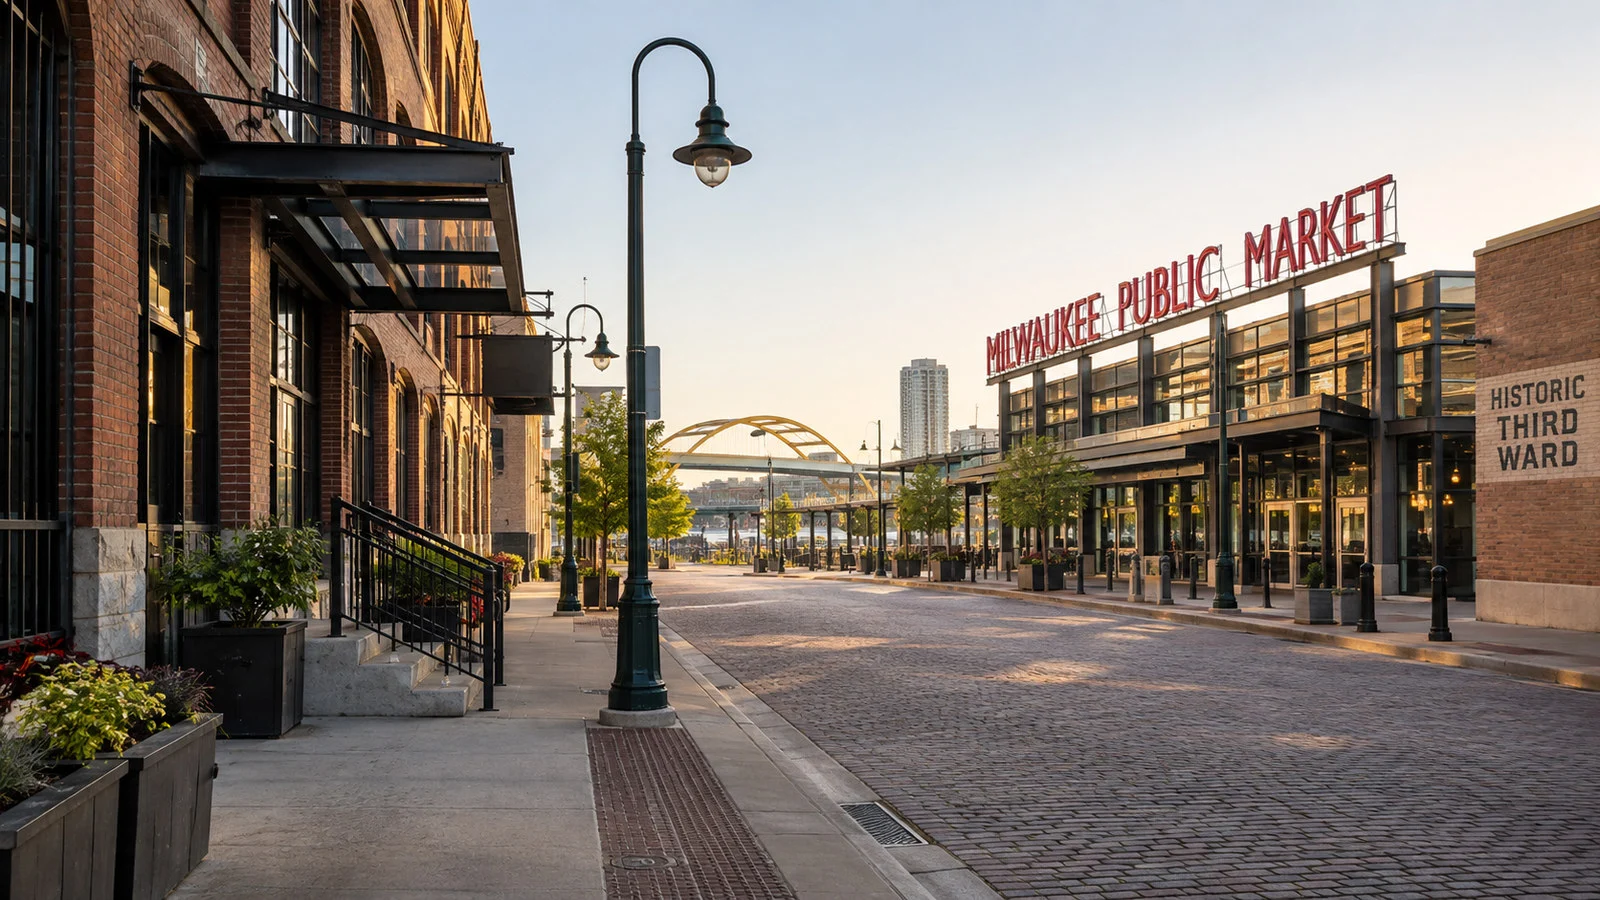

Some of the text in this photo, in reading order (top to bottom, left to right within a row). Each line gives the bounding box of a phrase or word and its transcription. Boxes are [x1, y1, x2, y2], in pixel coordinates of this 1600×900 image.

[986, 174, 1393, 376] MILWAUKEE PUBLIC MARKET
[1491, 374, 1585, 410] HISTORIC
[1497, 408, 1578, 440] THIRD
[1497, 440, 1578, 471] WARD
